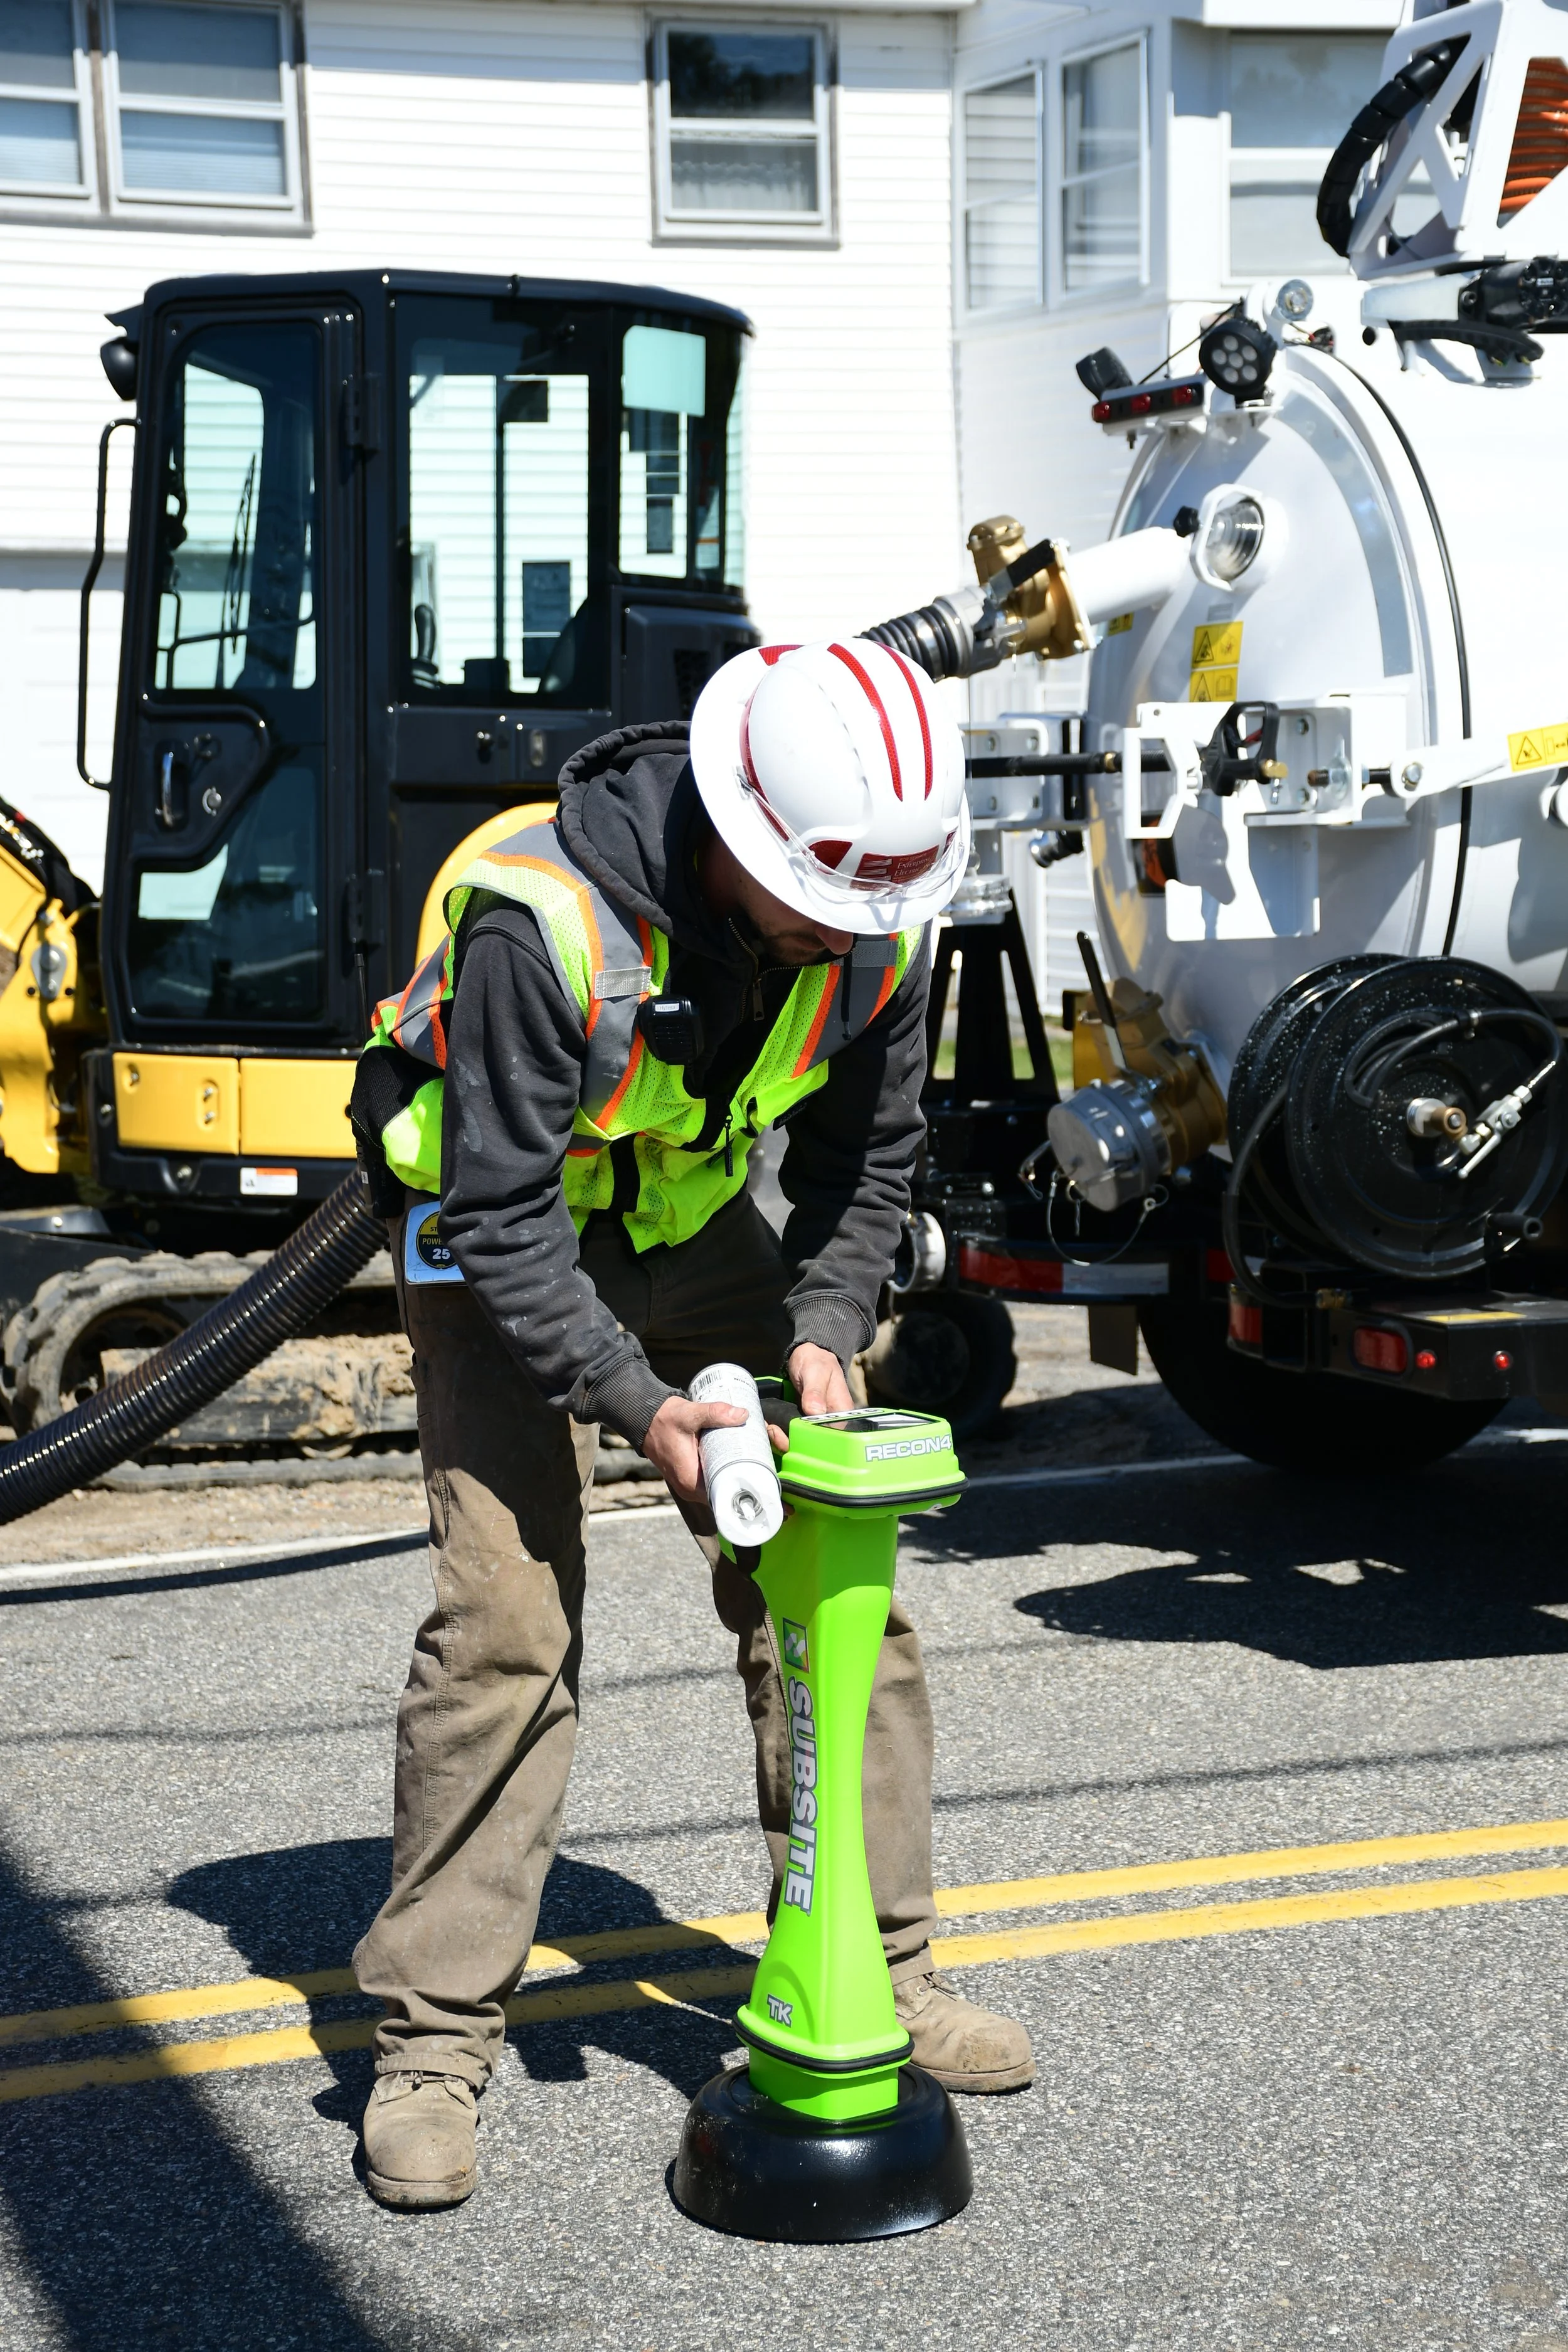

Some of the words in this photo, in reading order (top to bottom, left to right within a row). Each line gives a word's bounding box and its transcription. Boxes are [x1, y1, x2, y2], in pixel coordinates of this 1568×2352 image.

[432, 1248, 451, 1259] 25
[865, 1434, 952, 1463] RECON4
[785, 1675, 818, 1915] SUBSITE
[766, 1993, 793, 2028] TK
